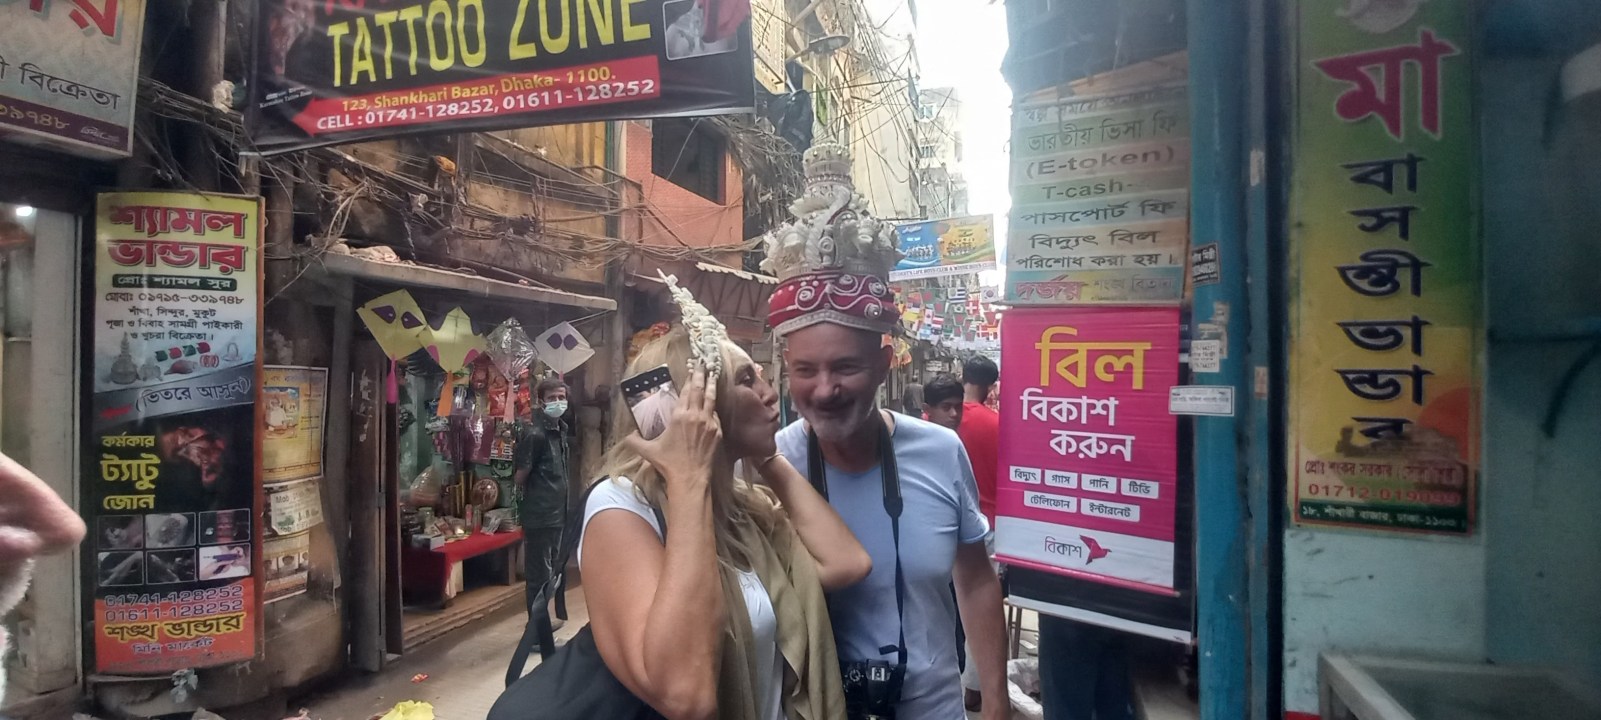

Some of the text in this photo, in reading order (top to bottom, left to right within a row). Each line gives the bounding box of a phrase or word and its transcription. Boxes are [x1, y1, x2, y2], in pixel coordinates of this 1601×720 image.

[327, 0, 652, 87] TATTOO ZONE
[19, 62, 120, 110] বিক্রেতা
[342, 66, 616, 114] 123, Shankhari Bazar, Dhaka- 1100.
[1309, 26, 1461, 141] মা
[317, 115, 353, 130] CELL
[365, 99, 500, 124] 01741-128252,
[502, 78, 655, 110] 01611-128252
[1028, 123, 1093, 151] ভারতীয়
[1100, 118, 1144, 143] ভিসা
[1026, 146, 1174, 179] (E-token)
[109, 204, 248, 239] শ্যামল
[1020, 199, 1176, 225] পাসপোর্ট ফি
[1029, 230, 1160, 251] বিদ্যুৎ বিল
[106, 239, 248, 275] ভান্ডার
[1015, 255, 1085, 270] পরিশোধ
[1090, 253, 1125, 267] করা
[1132, 252, 1162, 266] হয়
[152, 276, 201, 288] শ্যামল
[206, 278, 231, 290] সুর
[168, 331, 207, 342] বিক্রেতা
[202, 319, 243, 331] পাইকারী
[1034, 326, 1151, 390] বিল
[1020, 387, 1119, 426] বিকাশ
[102, 432, 155, 447] কর্মকার
[1050, 429, 1135, 462] করুন
[101, 453, 161, 490] ট্যাটু
[1014, 468, 1037, 482] বিদ্যুৎ
[1051, 473, 1071, 485] গ্যাস
[1089, 476, 1109, 489] পানি
[1128, 479, 1151, 494] টিভি
[103, 493, 155, 510] জোন
[1030, 494, 1070, 510] টেলিফোন
[1089, 502, 1131, 518] ইন্টারনেট
[1044, 536, 1082, 559] বিকাশ
[105, 585, 243, 607] 01741-128252
[105, 599, 243, 622] 01611-128252
[165, 614, 244, 639] ভান্ডার
